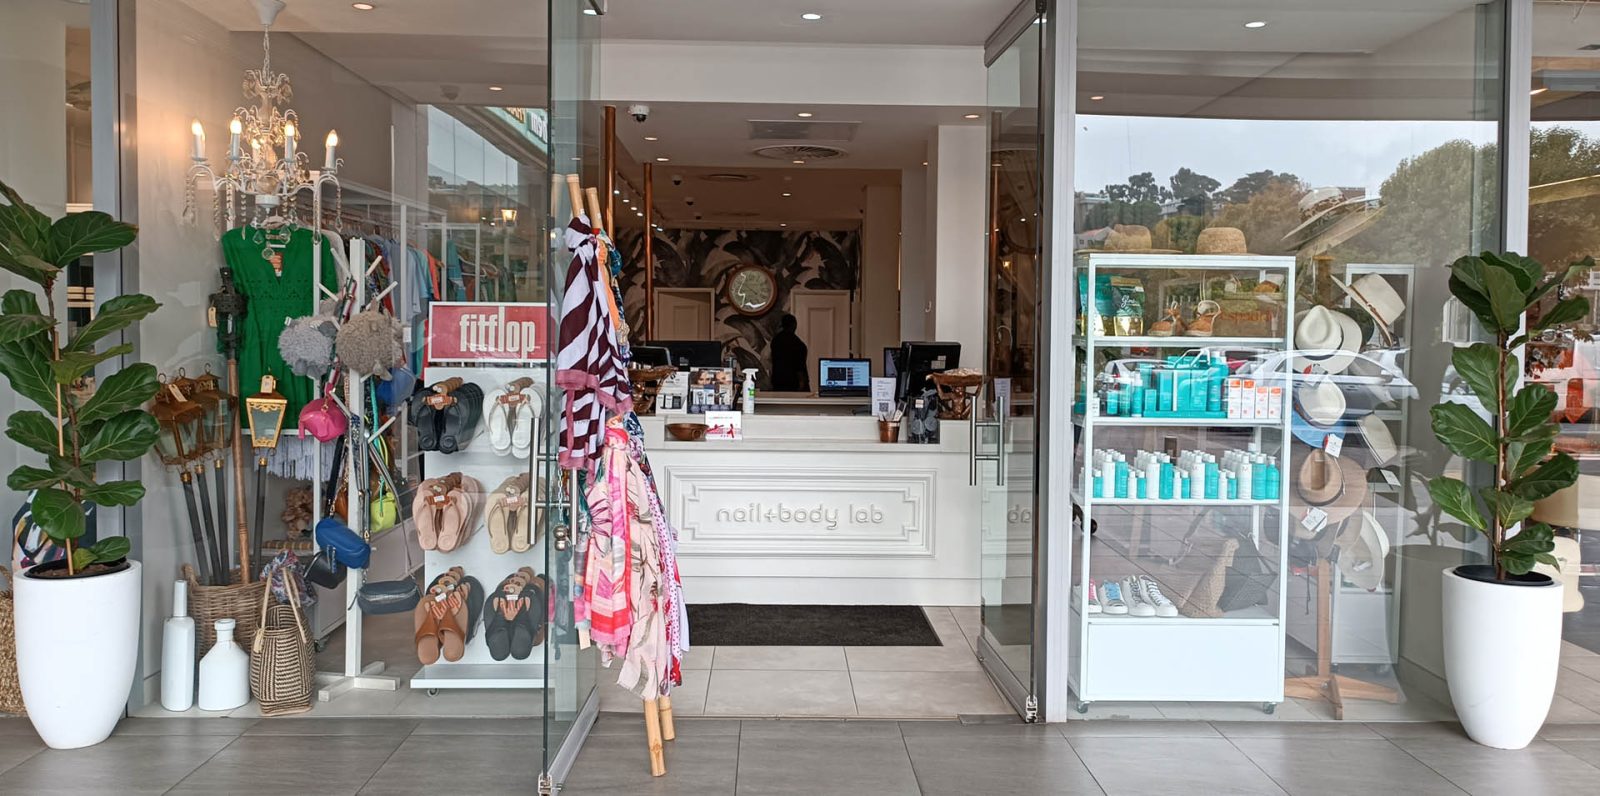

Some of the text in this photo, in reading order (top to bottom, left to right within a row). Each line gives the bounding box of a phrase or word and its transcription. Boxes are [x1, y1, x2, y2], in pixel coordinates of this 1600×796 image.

[459, 306, 536, 360] fitflop
[716, 502, 884, 531] nail+body lab
